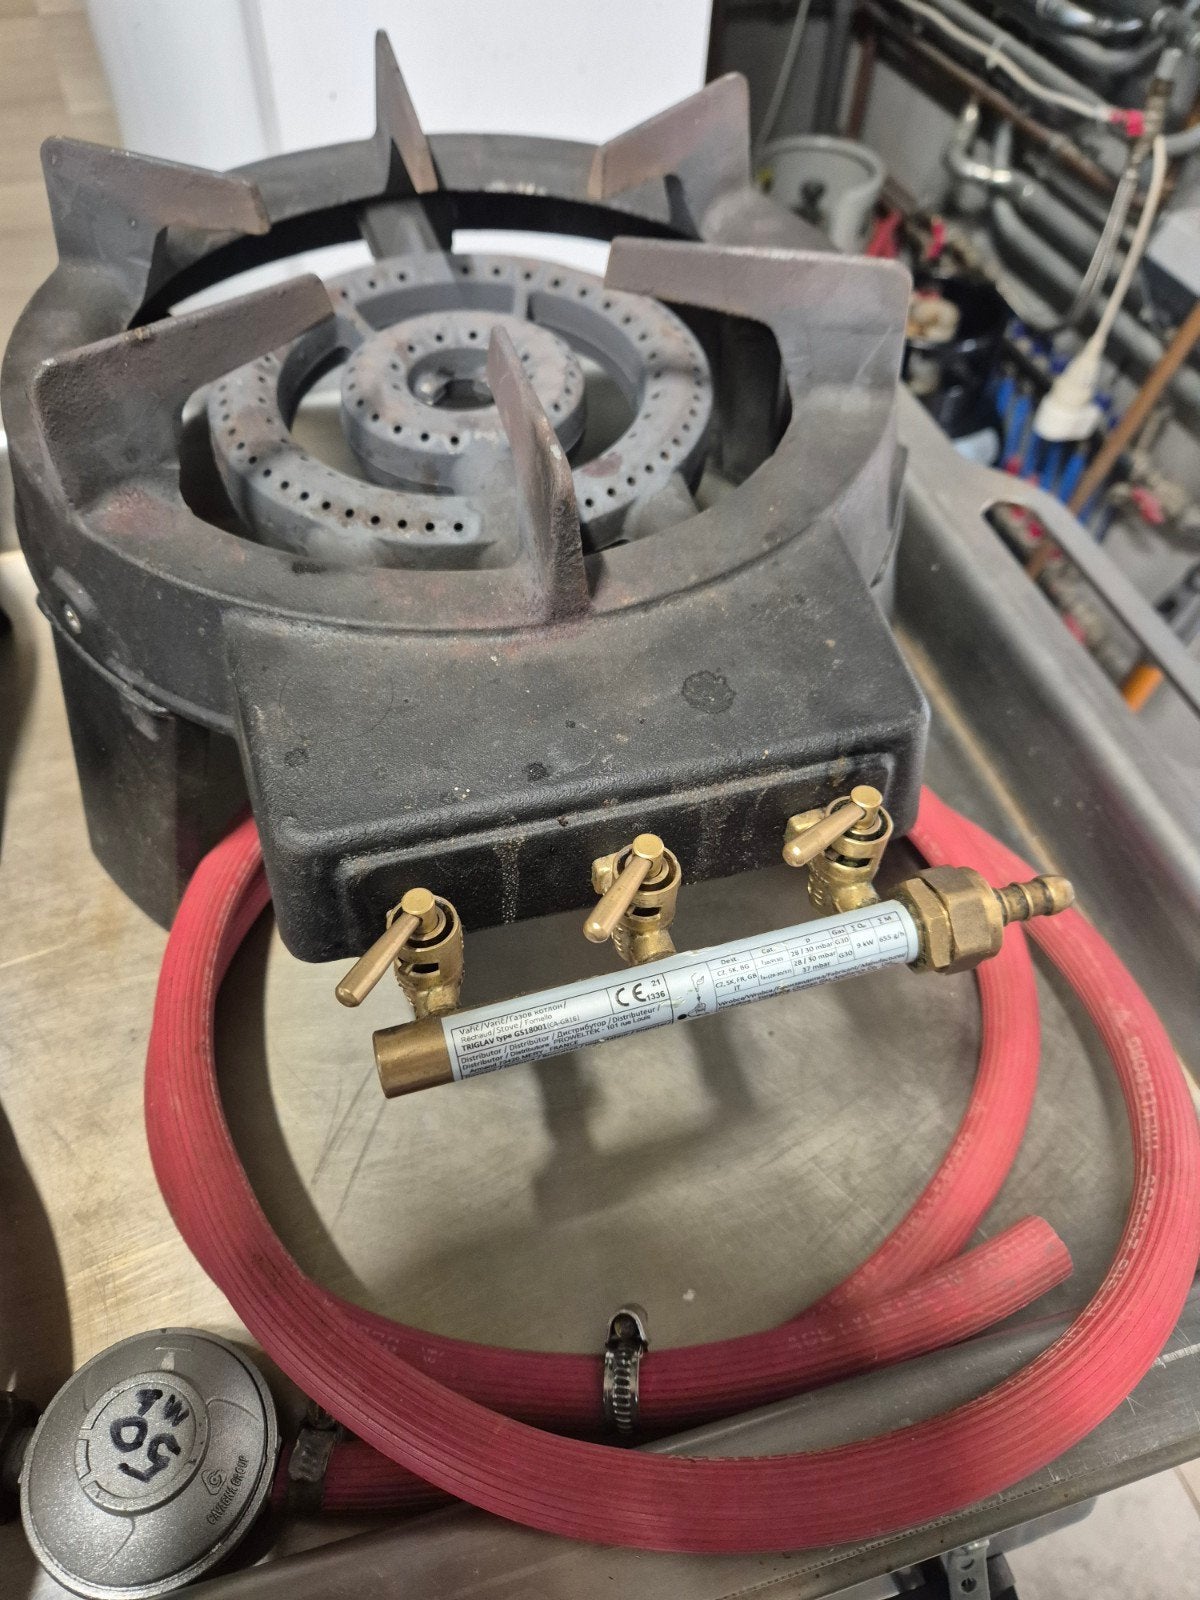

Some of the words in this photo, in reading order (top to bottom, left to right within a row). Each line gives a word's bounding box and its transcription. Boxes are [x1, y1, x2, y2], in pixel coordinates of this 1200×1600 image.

[831, 927, 845, 936] Gas
[815, 940, 833, 950] mbar
[818, 950, 836, 960] mbar
[812, 960, 830, 970] mbar
[651, 979, 661, 987] 21
[616, 983, 646, 1006] CE
[646, 990, 666, 1001] 1336
[461, 1047, 502, 1064] Distributor
[612, 1006, 656, 1023] Distributeur
[462, 1038, 495, 1051] TRIGLAV
[496, 1033, 513, 1043] type
[462, 1054, 503, 1070] Distributor
[553, 1028, 600, 1045] PROWELTEK
[606, 1022, 619, 1030] 101
[549, 1040, 578, 1052] FRANCE
[206, 1486, 237, 1525] CAVAGNA
[230, 1455, 249, 1487] GROUP
